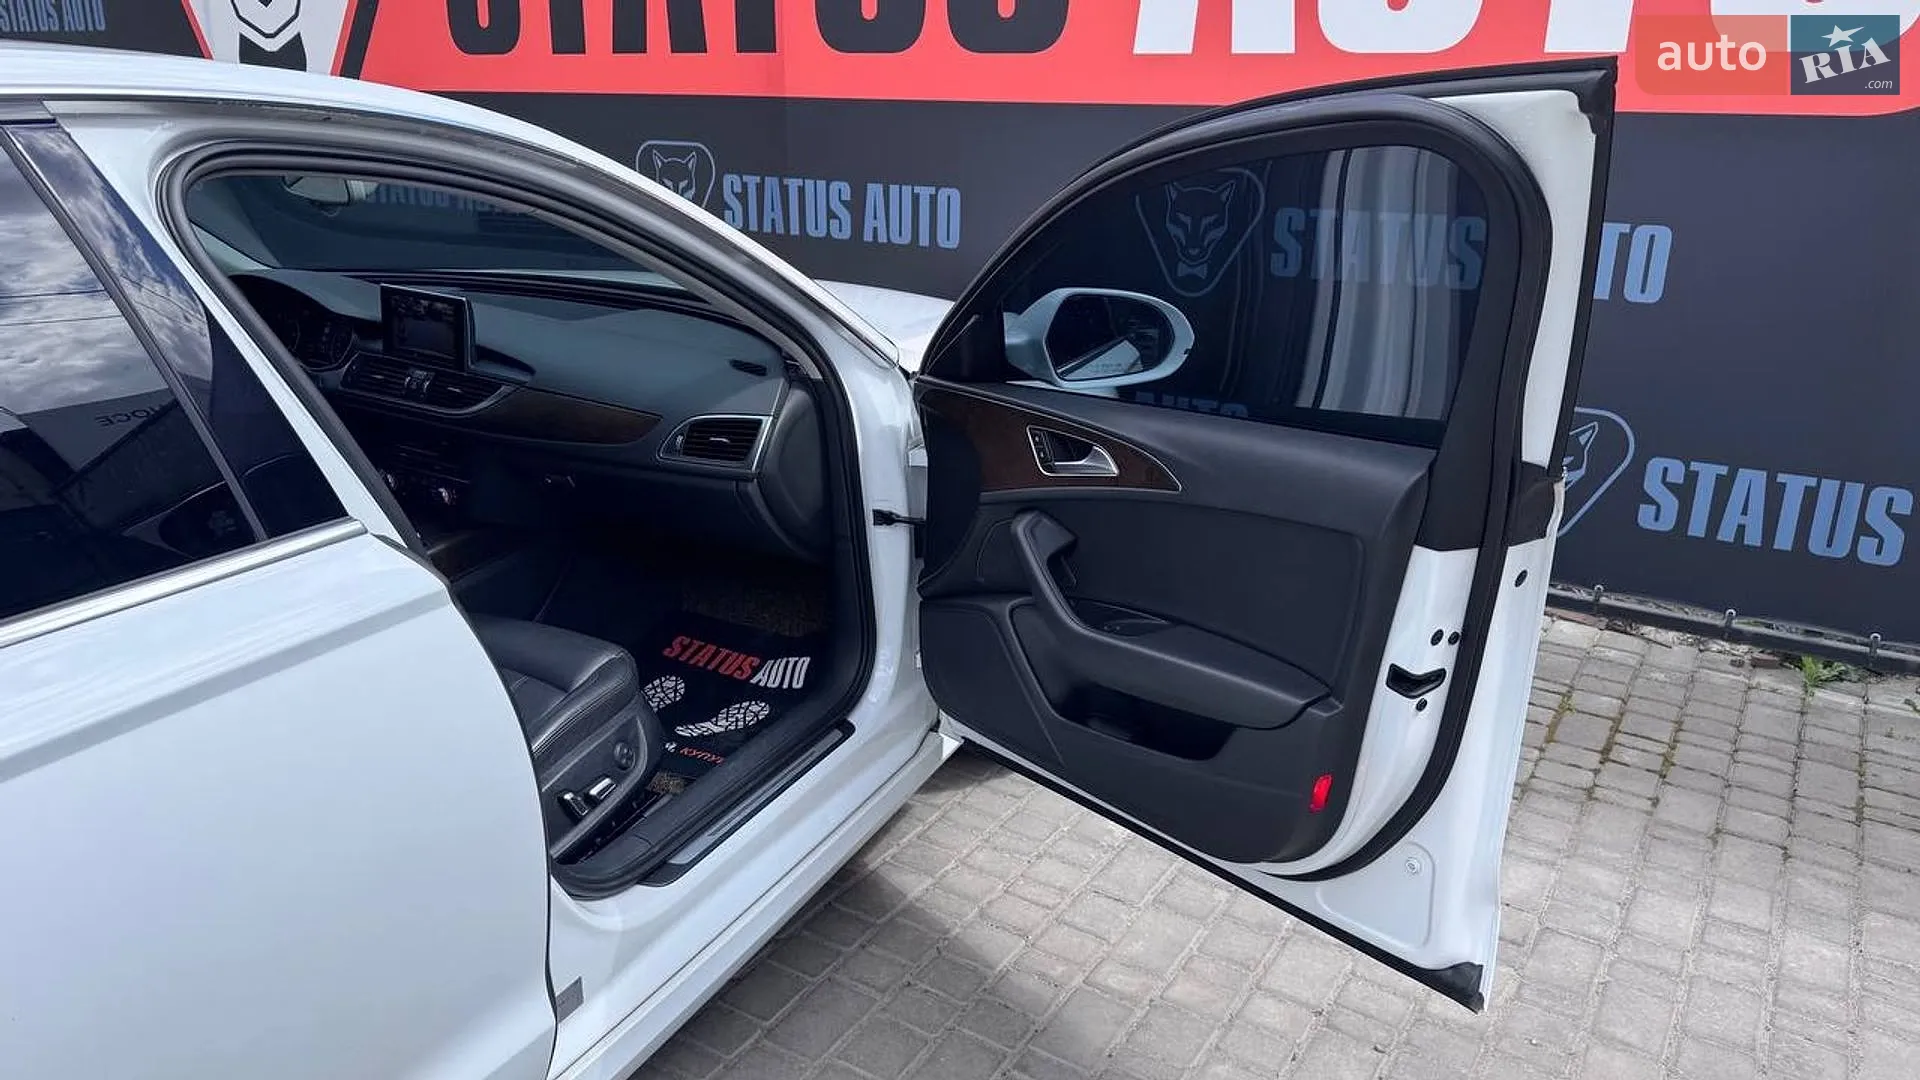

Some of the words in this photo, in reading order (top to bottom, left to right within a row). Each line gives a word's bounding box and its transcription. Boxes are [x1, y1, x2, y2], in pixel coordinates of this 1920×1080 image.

[722, 173, 851, 240] STATUS
[863, 183, 960, 249] AUTO
[1270, 207, 1488, 290] STATUS
[1593, 222, 1672, 304] TO
[1636, 456, 1914, 566] STATUS
[662, 635, 760, 680] STATUS
[749, 656, 811, 689] AUTO
